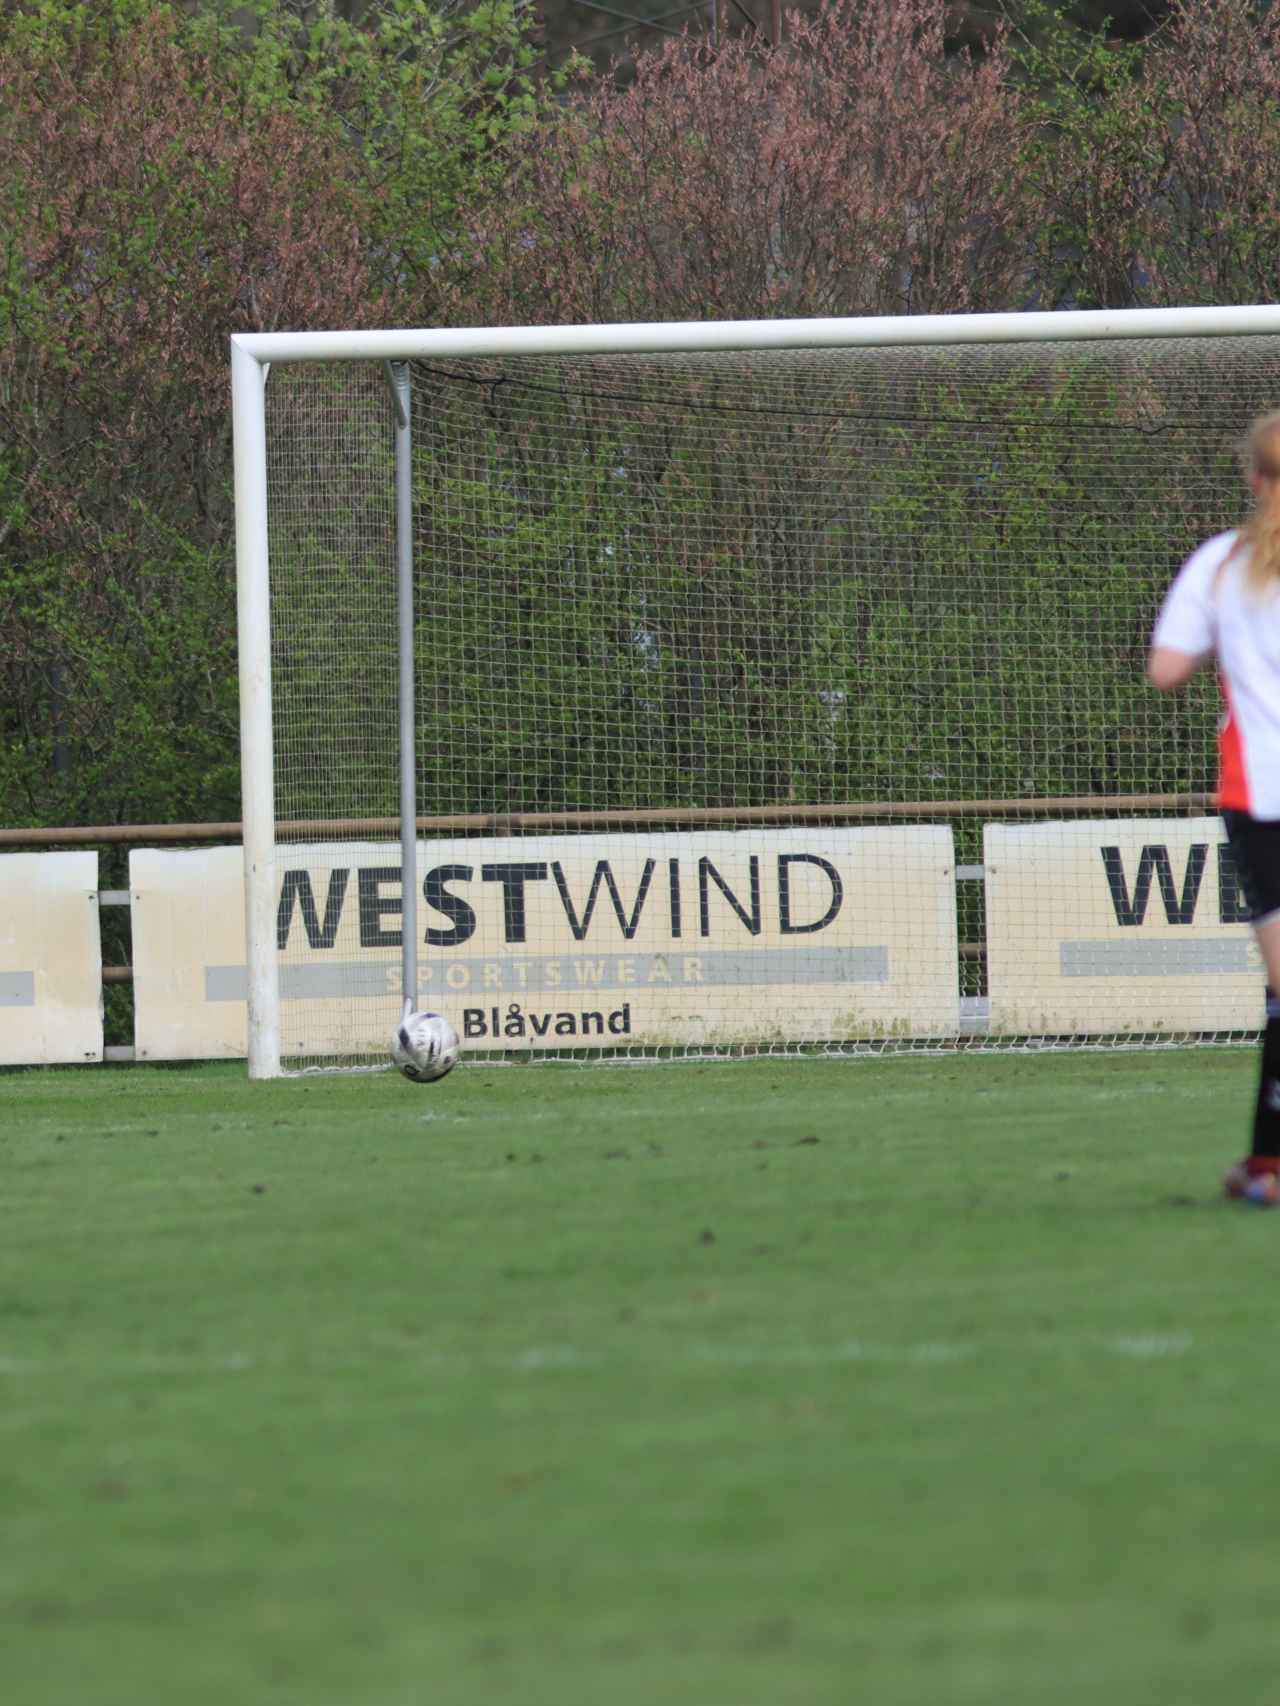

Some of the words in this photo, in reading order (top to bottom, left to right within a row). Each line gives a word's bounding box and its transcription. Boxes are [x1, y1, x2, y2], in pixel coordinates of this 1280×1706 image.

[276, 853, 844, 950] WESTWIND
[385, 954, 705, 991] SPORTSWEAR
[463, 1003, 632, 1039] Blåvand
